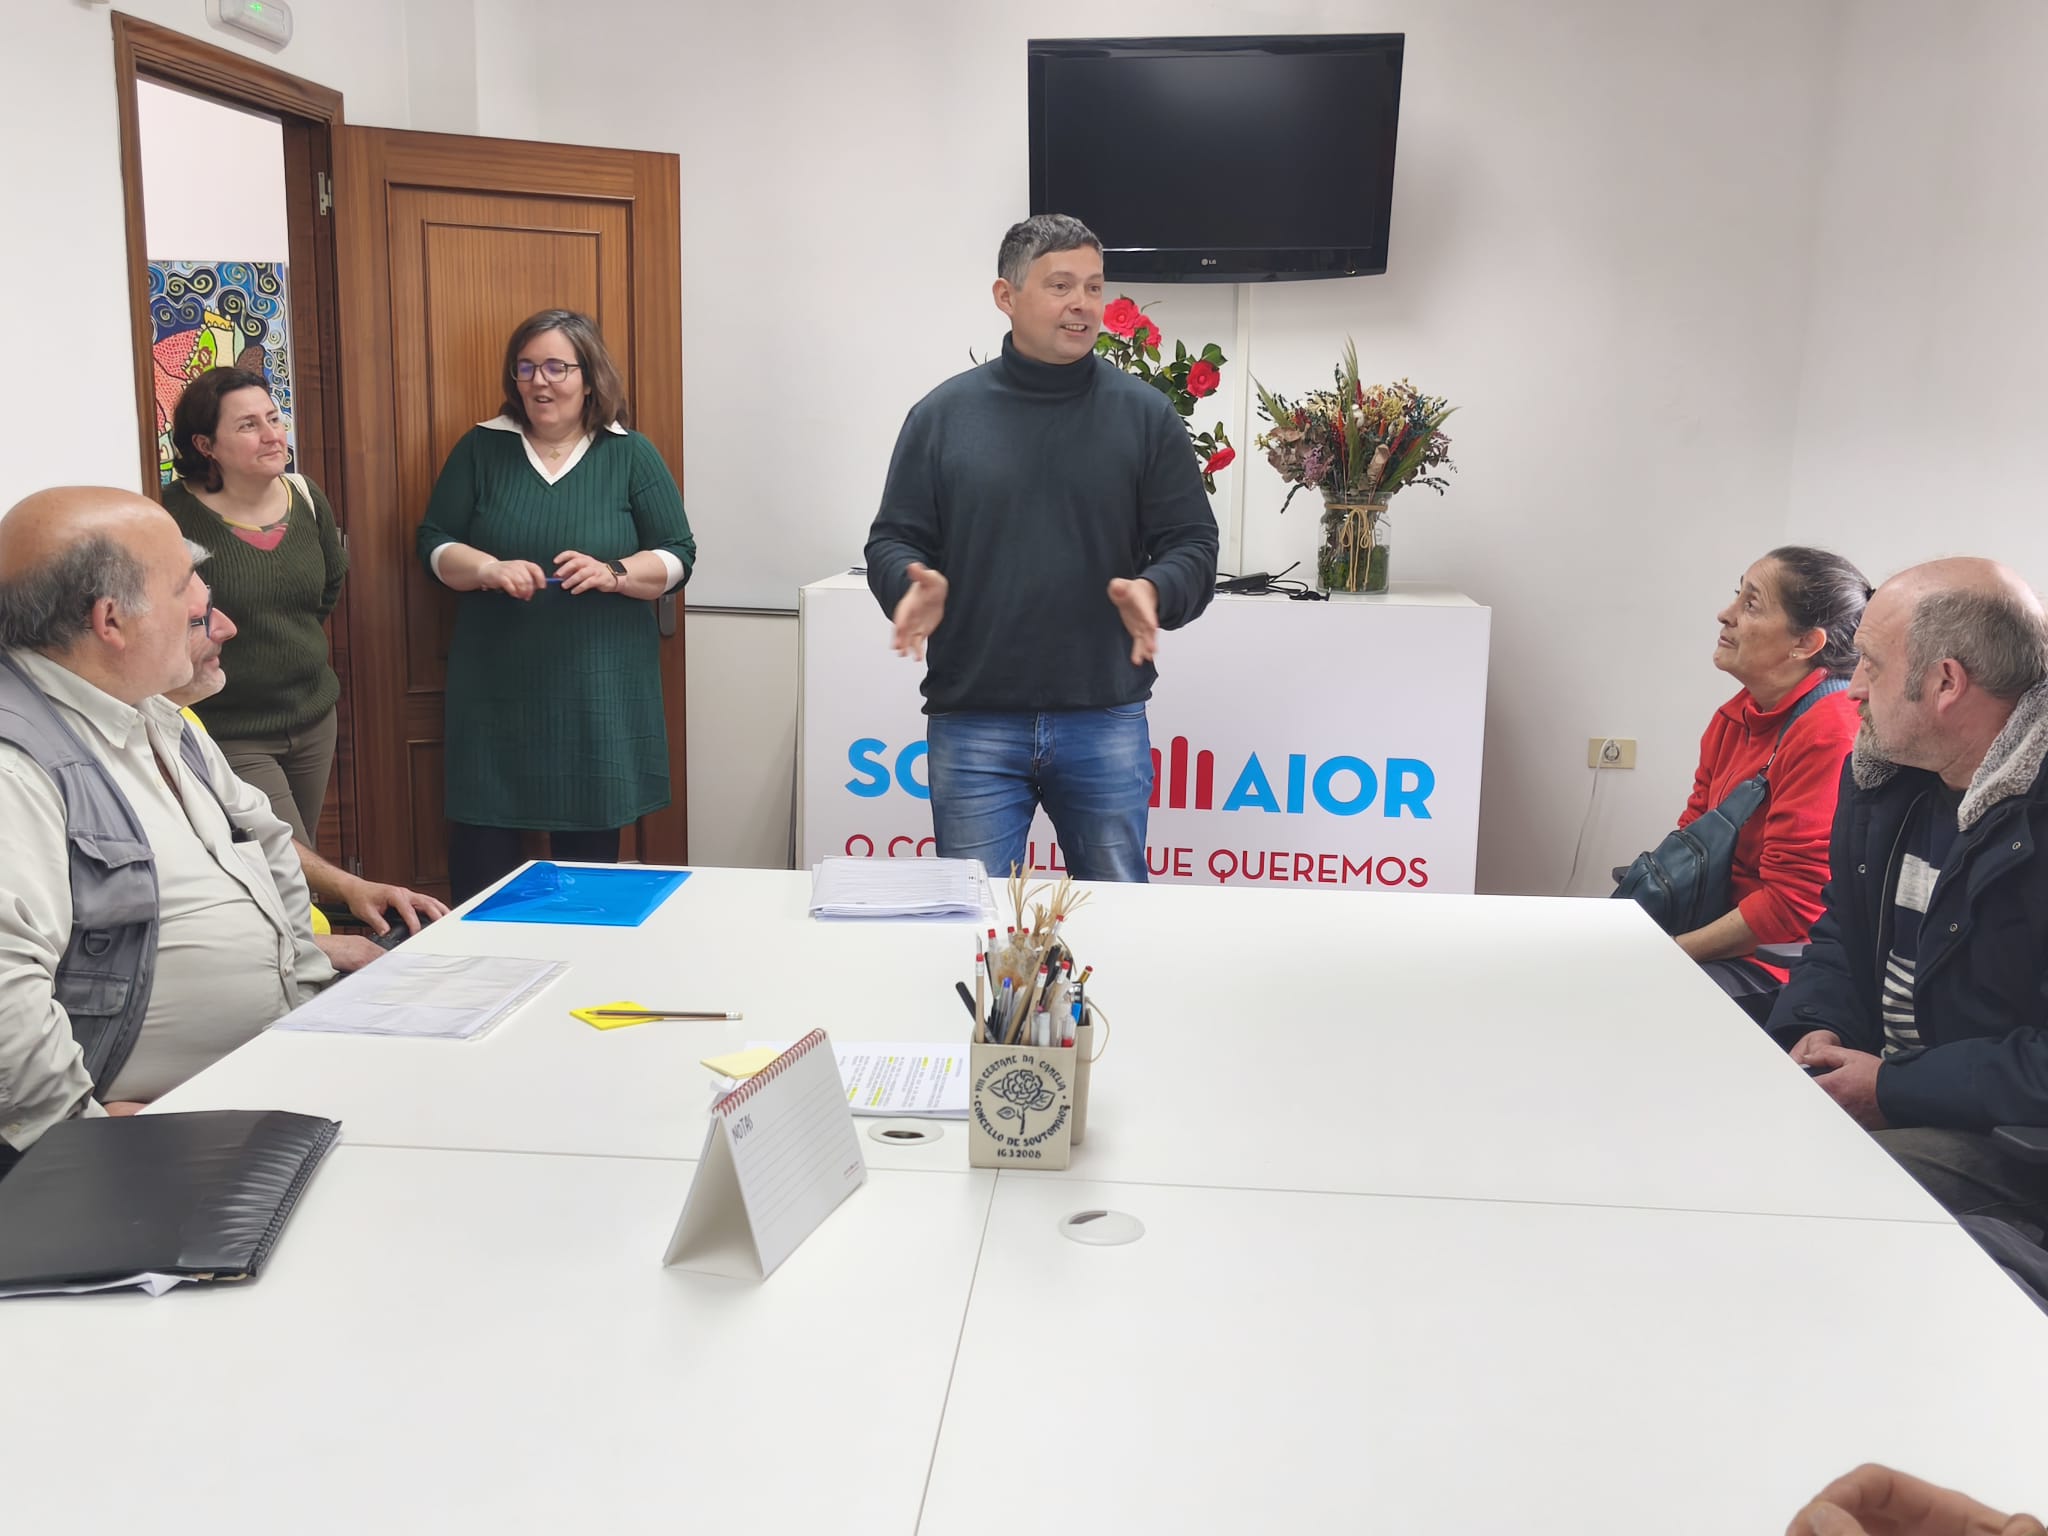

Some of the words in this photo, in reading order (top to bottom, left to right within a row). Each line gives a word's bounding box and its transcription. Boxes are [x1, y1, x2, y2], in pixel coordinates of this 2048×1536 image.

[845, 834, 874, 857] O
[1146, 847, 1193, 877] UE
[1208, 849, 1429, 888] QUEREMOS
[982, 1055, 1017, 1079] CERTAME
[1039, 1060, 1066, 1092] CAMELIA
[731, 1113, 754, 1145] NOTAS
[974, 1100, 1004, 1142] CONCELLO
[1006, 1137, 1020, 1147] DE
